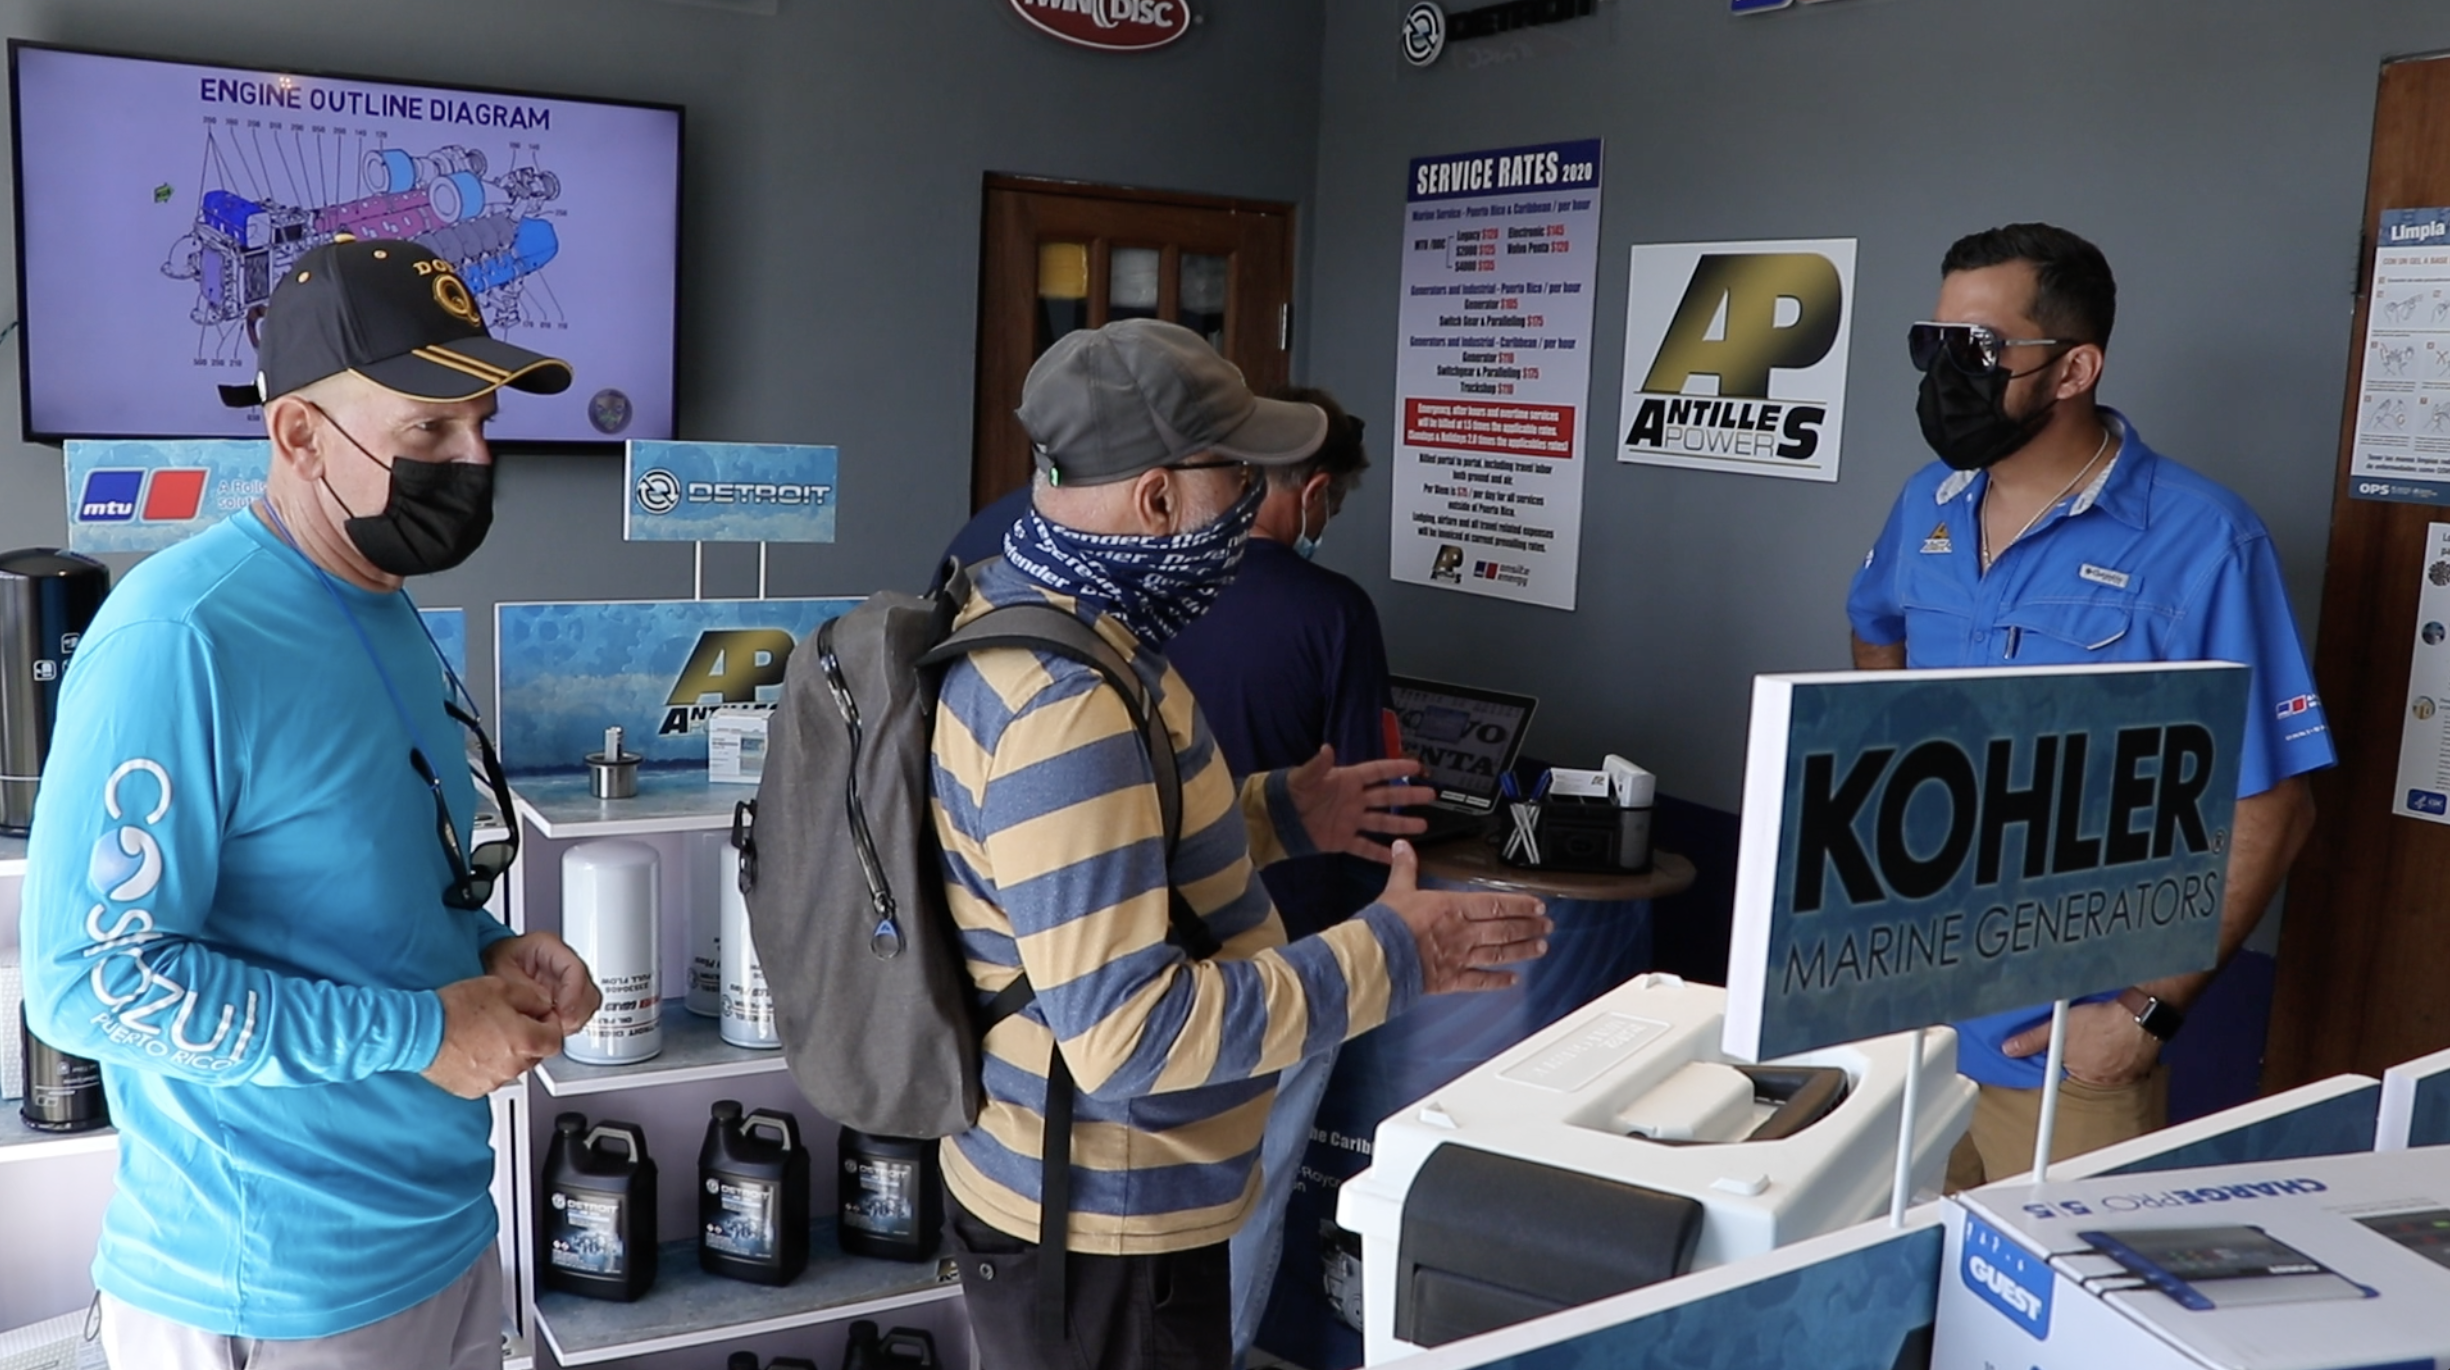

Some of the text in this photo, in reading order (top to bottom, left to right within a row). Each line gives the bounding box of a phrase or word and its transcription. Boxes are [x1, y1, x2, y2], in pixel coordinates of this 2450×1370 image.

[1024, 0, 1173, 27] WIN DISC
[201, 78, 550, 131] ENGINE OUTLINE DIAGRAM
[1416, 151, 1593, 195] SERVICE RATES 2020
[1436, 209, 1460, 220] Service
[1466, 207, 1489, 218] Puerto
[1490, 206, 1505, 216] Rico
[1514, 203, 1552, 214] Caribbean
[1558, 202, 1571, 212] per
[1572, 200, 1591, 211] hour
[1456, 230, 1480, 242] Legacy
[1508, 226, 1544, 239] Electronic
[2391, 220, 2446, 242] Limpia
[1508, 244, 1526, 254] Volvo
[1528, 243, 1548, 254] Penta
[1410, 285, 1446, 296] Generators
[1448, 285, 1460, 295] and
[1462, 283, 1495, 294] Industrial
[1501, 282, 1524, 294] Puerto
[1526, 282, 1542, 293] Rico
[1550, 283, 1562, 294] per
[1564, 282, 1581, 293] hour
[1464, 298, 1498, 310] Generator
[1440, 315, 1461, 327] Switch
[1464, 316, 1478, 326] Gear
[1641, 252, 1843, 400] AP
[1410, 336, 1446, 347] Generators
[1447, 336, 1460, 346] and
[1462, 336, 1495, 347] Industrial
[1500, 336, 1537, 348] Caribbean
[1544, 339, 1556, 350] per
[1558, 338, 1576, 349] hour
[1462, 352, 1496, 363] Generator
[1437, 365, 1474, 377] Switchgear
[1460, 382, 1496, 394] Truckshop
[1486, 407, 1499, 418] and
[1492, 422, 1502, 432] the
[1625, 398, 1826, 460] ANTILLES
[1497, 436, 1506, 446] the
[1665, 426, 1775, 458] POWER
[1436, 454, 1455, 465] portal
[1484, 457, 1513, 472] including
[1514, 460, 1534, 472] travel
[1535, 462, 1552, 474] labor
[1468, 472, 1489, 482] ground
[1491, 474, 1502, 484] and
[219, 482, 229, 493] A
[688, 482, 832, 506] DETROIT
[1424, 482, 1433, 493] Per
[1472, 490, 1483, 499] per
[1484, 490, 1496, 500] day
[1516, 494, 1544, 506] services
[2359, 483, 2390, 496] OPS
[83, 501, 133, 516] mtu
[1478, 504, 1498, 515] Puerto
[1438, 514, 1456, 526] airfare
[1458, 518, 1470, 527] and
[1480, 520, 1497, 530] travel
[1523, 526, 1554, 538] expenses
[1438, 530, 1463, 540] invoiced
[1471, 532, 1494, 544] current
[1496, 536, 1526, 550] prevailing
[665, 630, 796, 706] AP
[1792, 722, 2215, 913] KOHLER
[1783, 871, 2218, 995] MARINE GENERATORS
[90, 1012, 232, 1071] PUERTO RICO
[566, 1199, 619, 1214] DETROIT
[1968, 1255, 2042, 1322] GUEST
